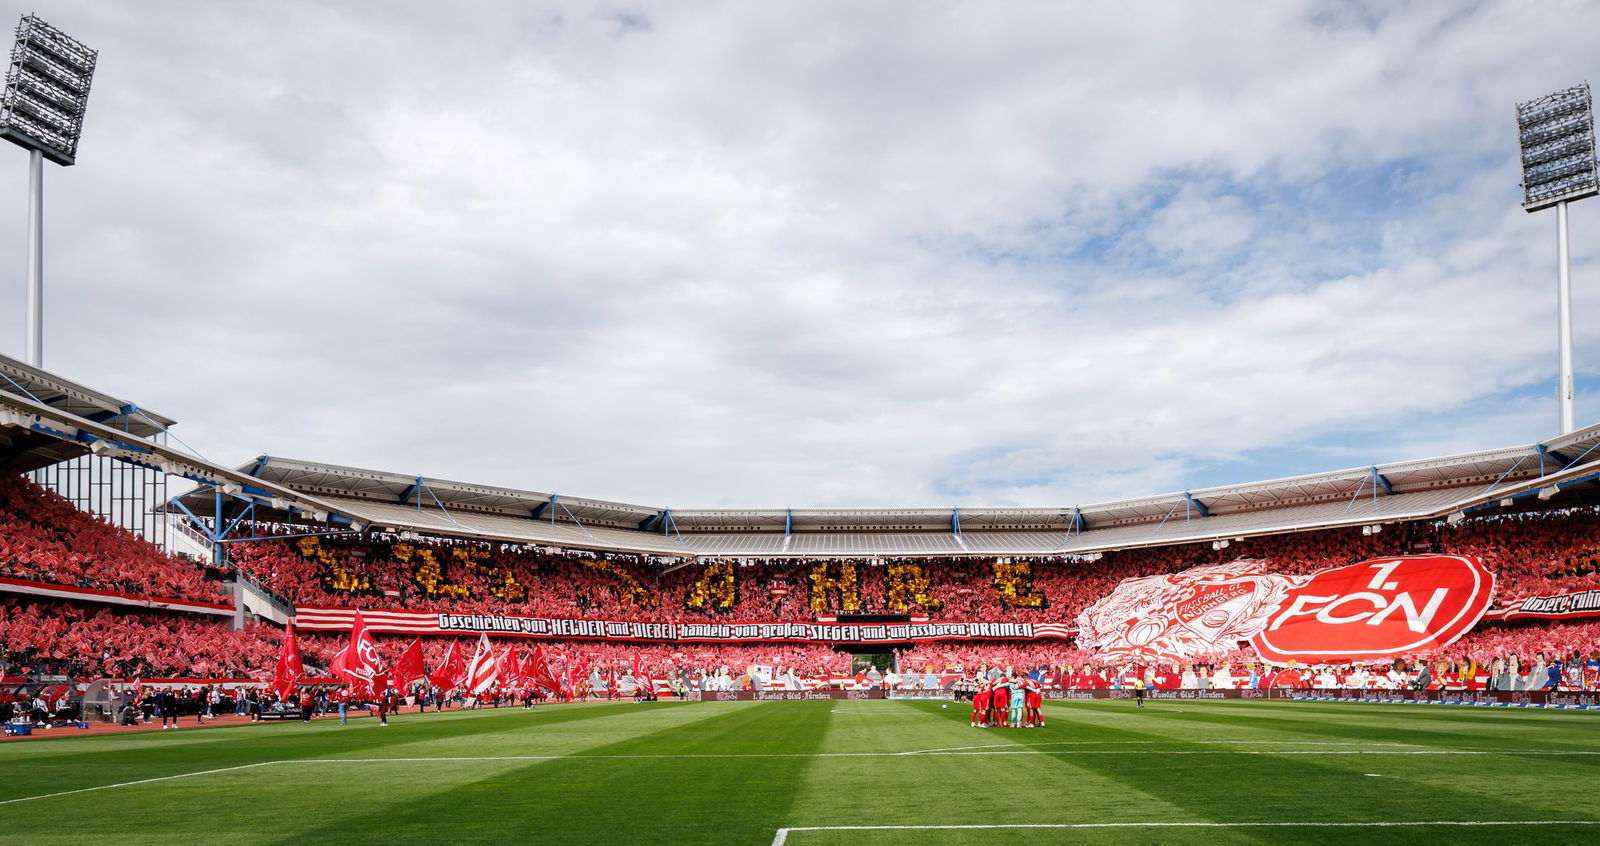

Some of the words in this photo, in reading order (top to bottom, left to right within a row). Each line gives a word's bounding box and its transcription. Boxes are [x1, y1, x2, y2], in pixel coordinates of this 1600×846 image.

[1367, 560, 1403, 591] 1.
[1268, 587, 1449, 634] FCN
[1520, 595, 1568, 613] Unsere
[438, 613, 521, 632] Geschichten
[523, 619, 548, 633] von
[552, 618, 606, 636] HELDEN
[608, 621, 630, 636] und
[632, 622, 677, 639] DIEBEN
[681, 623, 731, 638] handeln
[734, 625, 760, 638] von
[762, 623, 807, 638] großen
[809, 624, 860, 641] SIEGEN
[862, 626, 887, 640] und
[889, 622, 967, 639] unfassbaren
[969, 622, 1034, 638] DRAMEN
